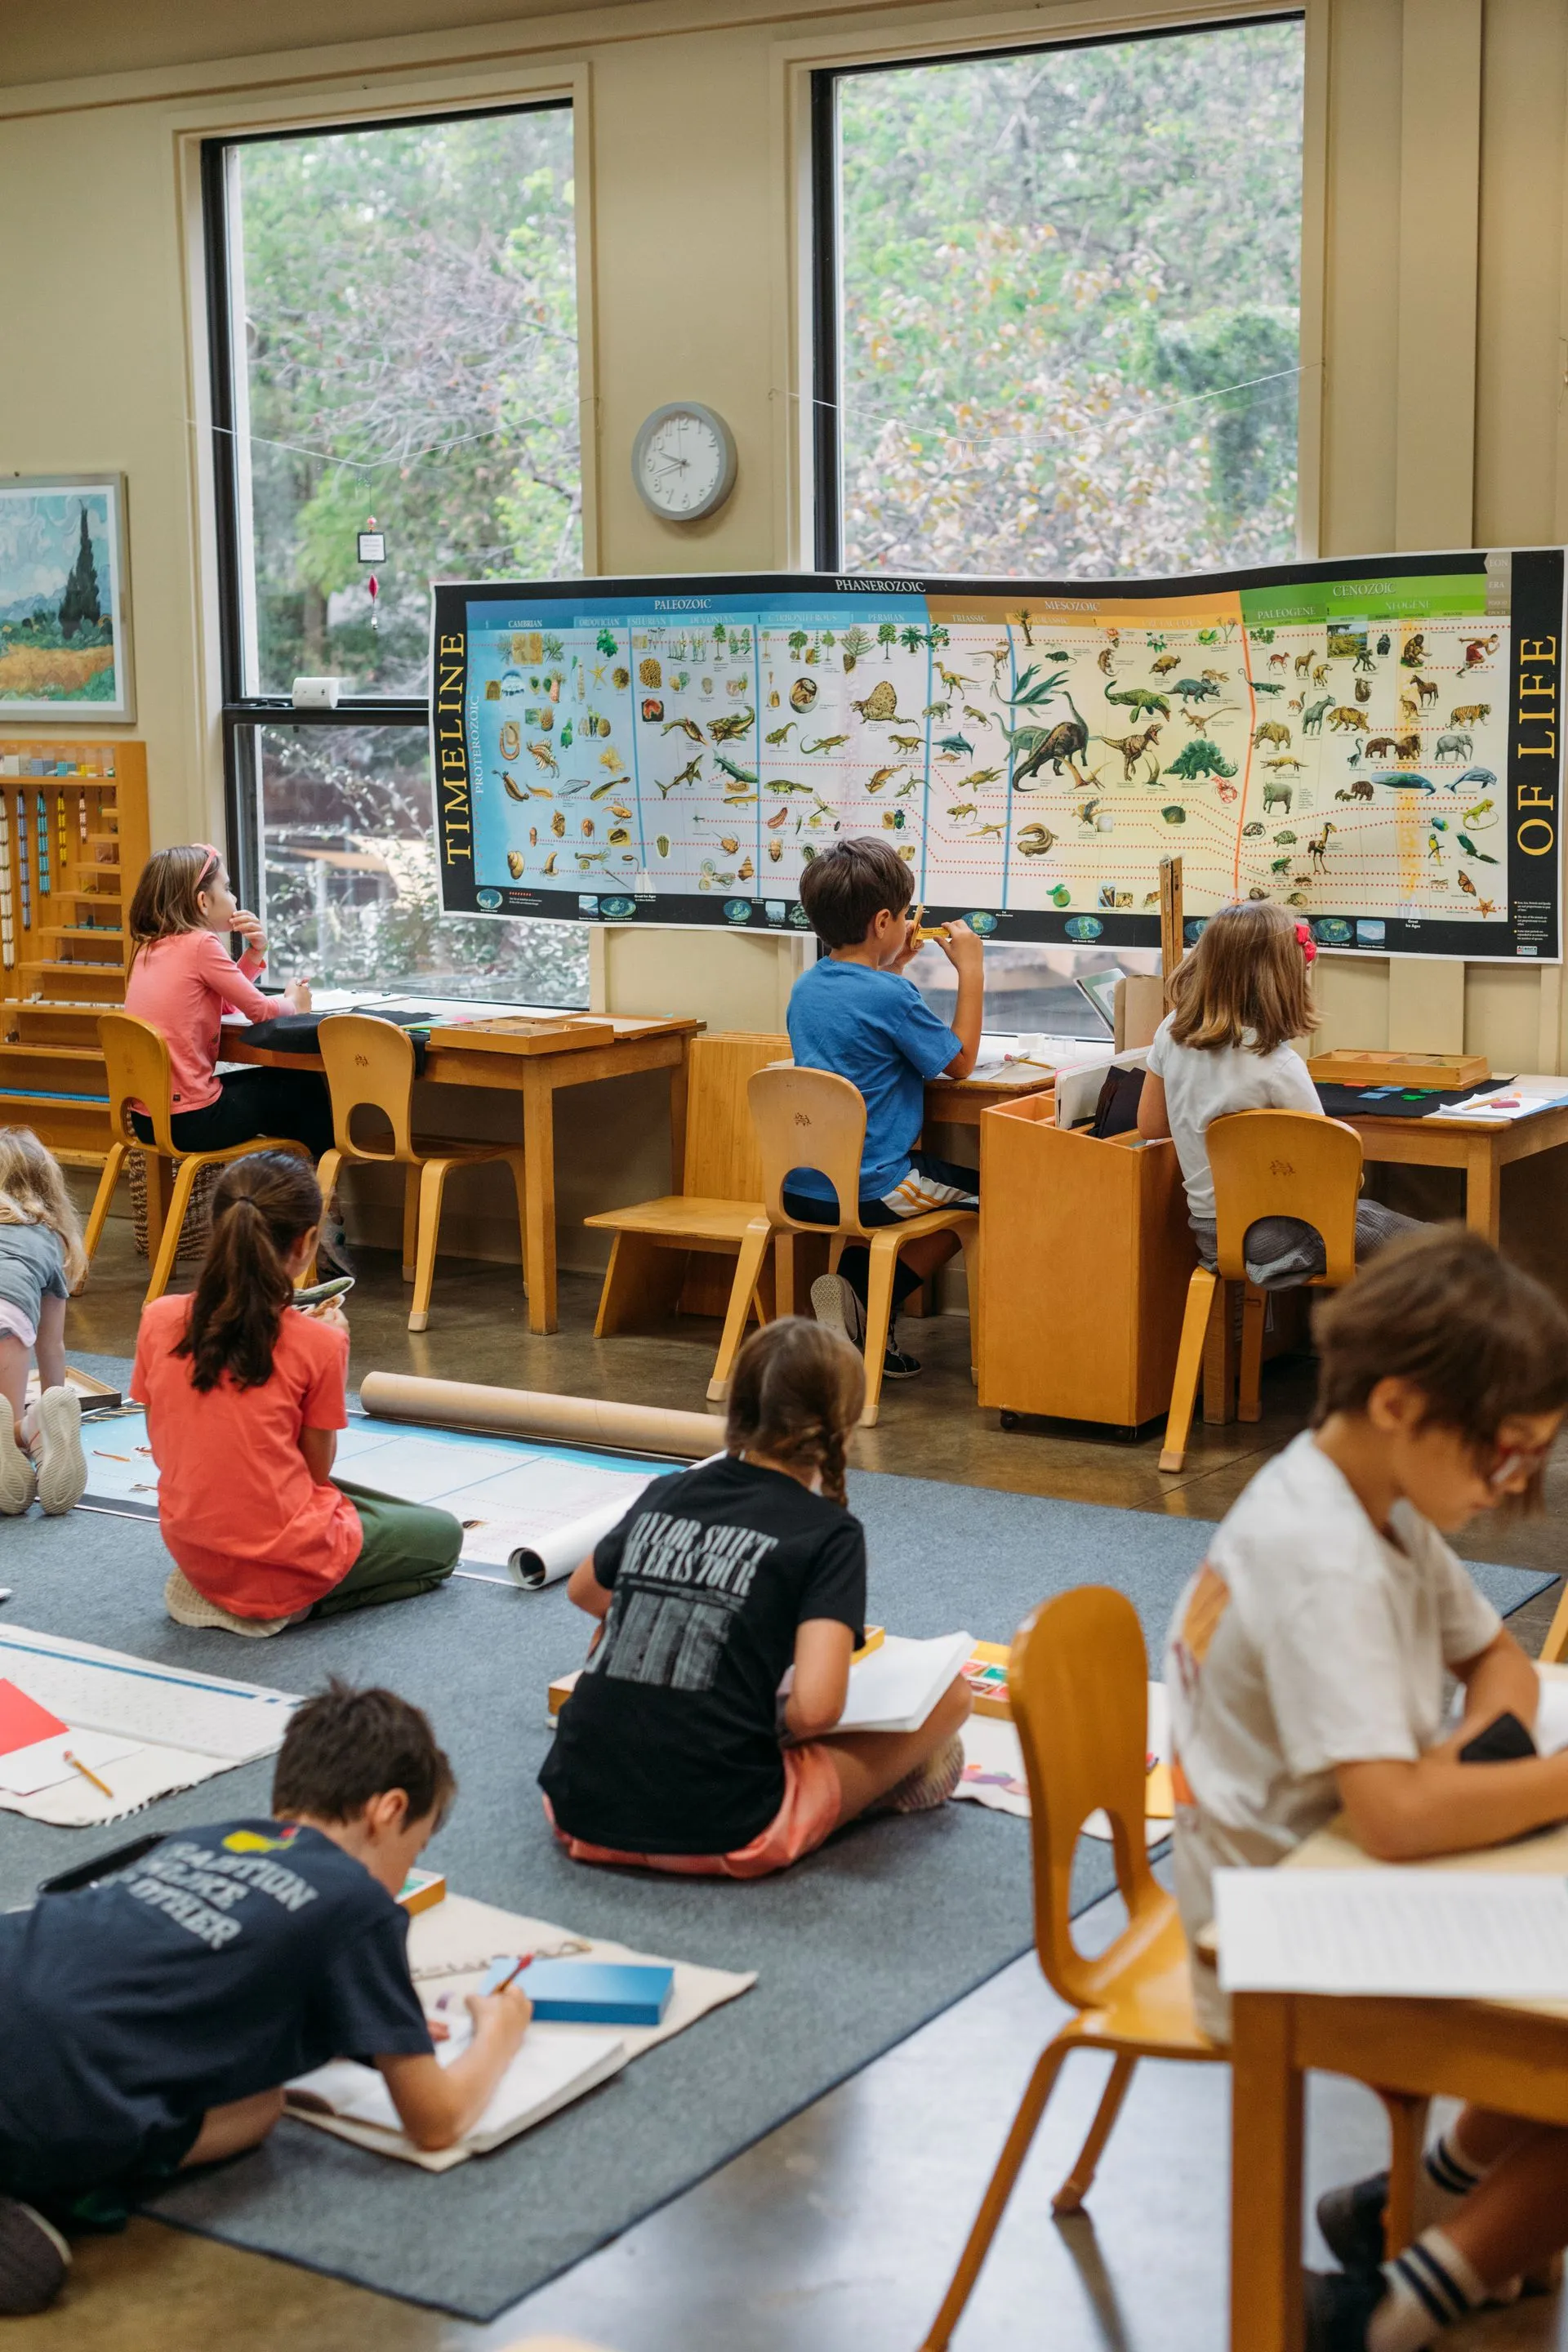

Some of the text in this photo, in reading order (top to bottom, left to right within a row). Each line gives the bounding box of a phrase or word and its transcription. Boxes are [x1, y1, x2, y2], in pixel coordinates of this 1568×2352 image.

[1489, 559, 1509, 568] EON
[835, 578, 926, 593] PHANEROZOIC
[1332, 582, 1396, 597] CENOZOIC
[1489, 581, 1505, 589] ERA
[654, 599, 712, 611] PALEOZOIC
[1045, 599, 1102, 612] MESOZOIC
[768, 612, 839, 622] CARBONIFEROUS
[868, 612, 905, 622] PERMIAN
[951, 613, 987, 623] TRIASSIC
[1258, 606, 1316, 620] PALEOGENE
[508, 619, 543, 628] CAMBRIAN
[1517, 635, 1557, 760] LIFE
[439, 632, 471, 866] TIMELINE
[470, 695, 483, 794] PROTEROZOIC
[1517, 784, 1555, 857] OF
